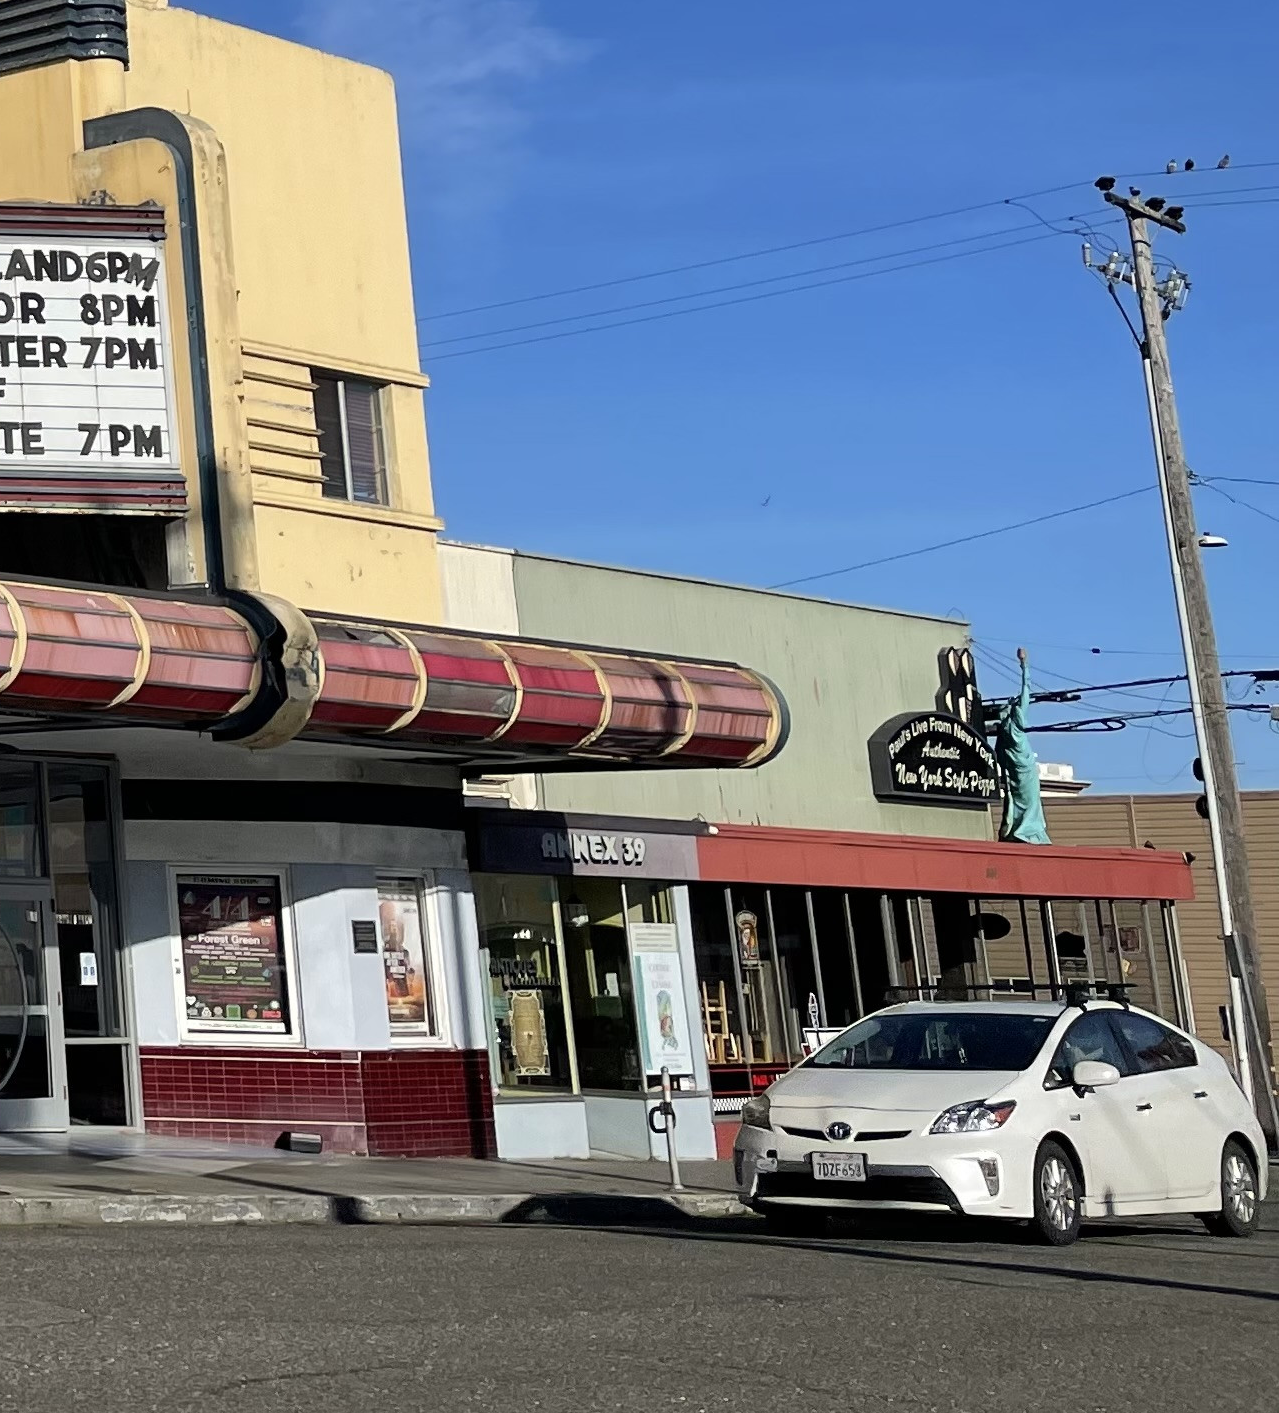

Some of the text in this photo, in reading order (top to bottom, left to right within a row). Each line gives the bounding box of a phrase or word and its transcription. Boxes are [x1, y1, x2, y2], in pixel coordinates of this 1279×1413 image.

[86, 251, 160, 292] 6PM
[79, 293, 156, 328] 8PM
[80, 337, 158, 371] 7PM
[889, 717, 994, 769] Paul's Live From New York
[921, 740, 960, 759] Authentic
[896, 763, 995, 796] New York Style Pizza
[542, 832, 646, 865] ANNEX 39
[201, 896, 249, 920] 4/4
[198, 934, 261, 945] Forest Green
